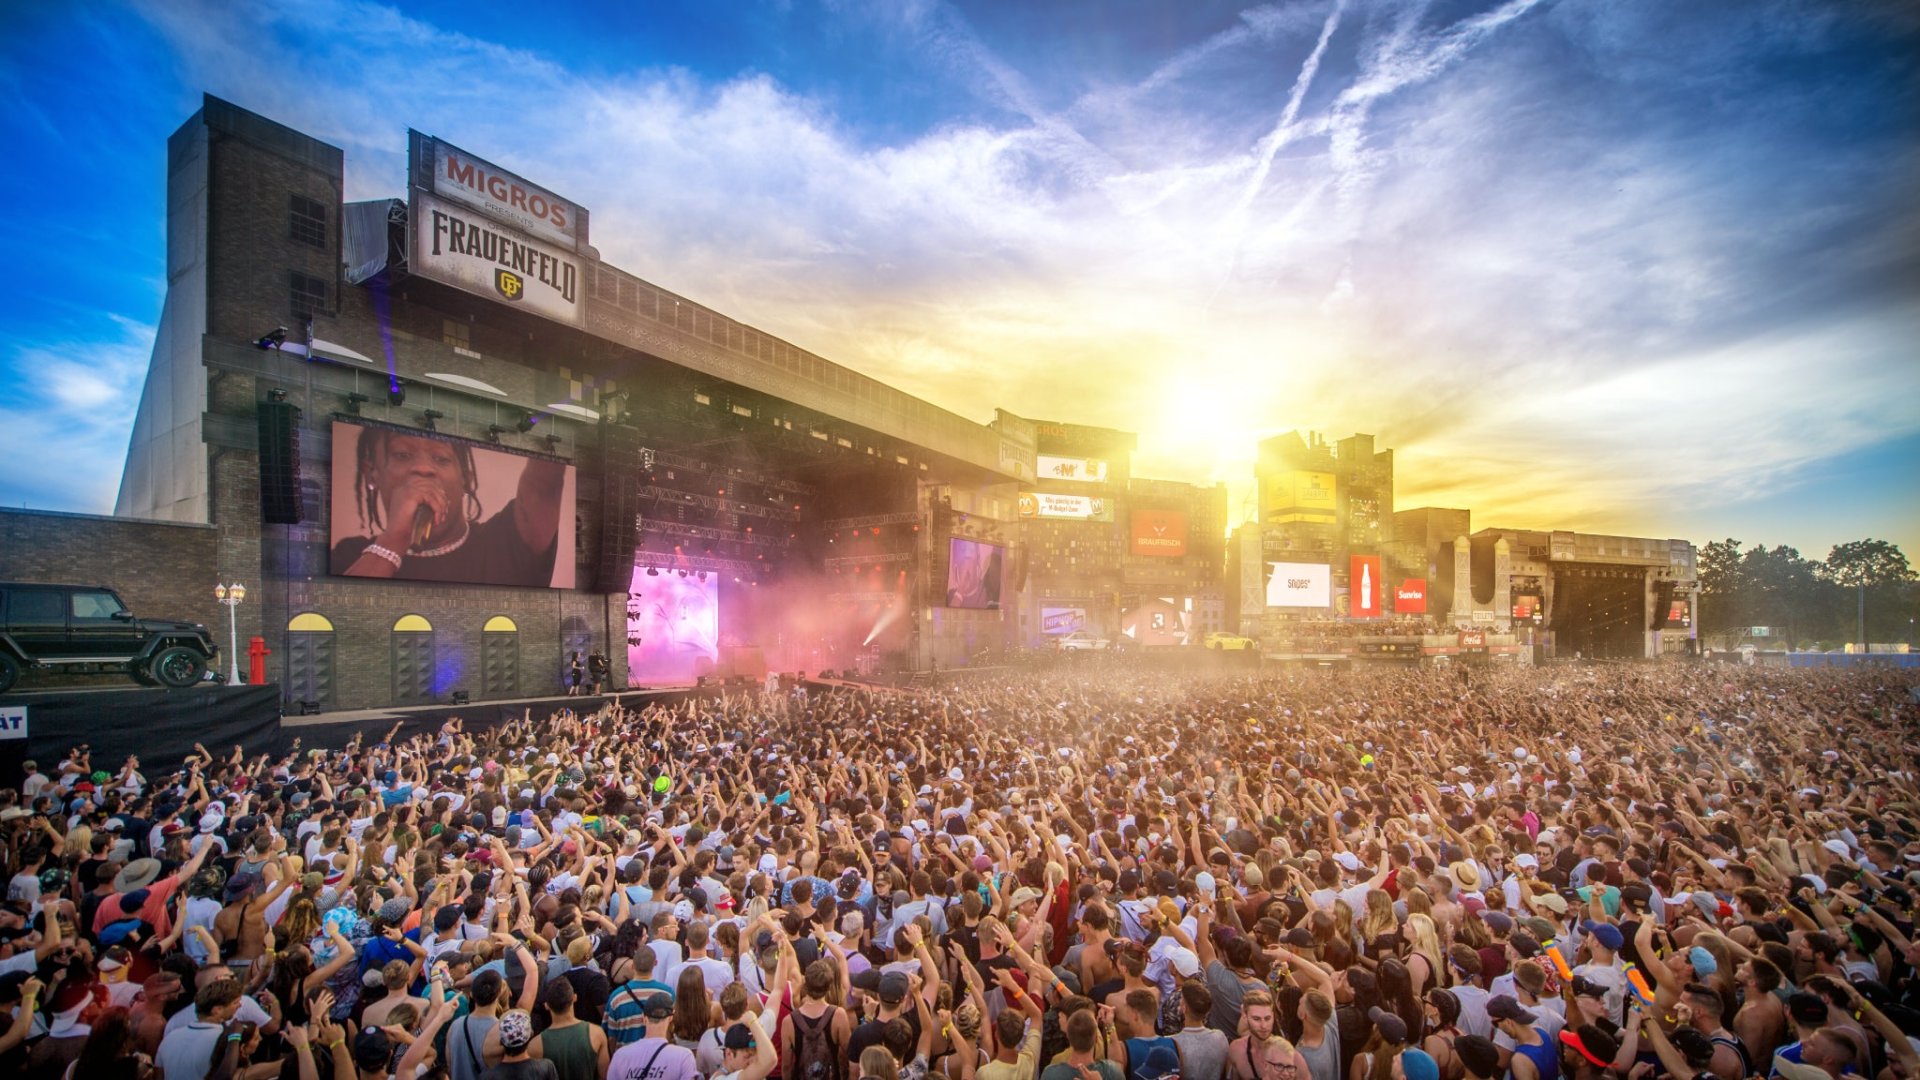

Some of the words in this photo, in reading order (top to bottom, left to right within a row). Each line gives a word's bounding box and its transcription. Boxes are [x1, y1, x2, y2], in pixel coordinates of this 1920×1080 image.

[447, 155, 567, 229] MIGROS
[485, 201, 534, 228] PRESENTS
[432, 209, 576, 304] FRAUENFELD
[1398, 590, 1422, 600] Sunrise
